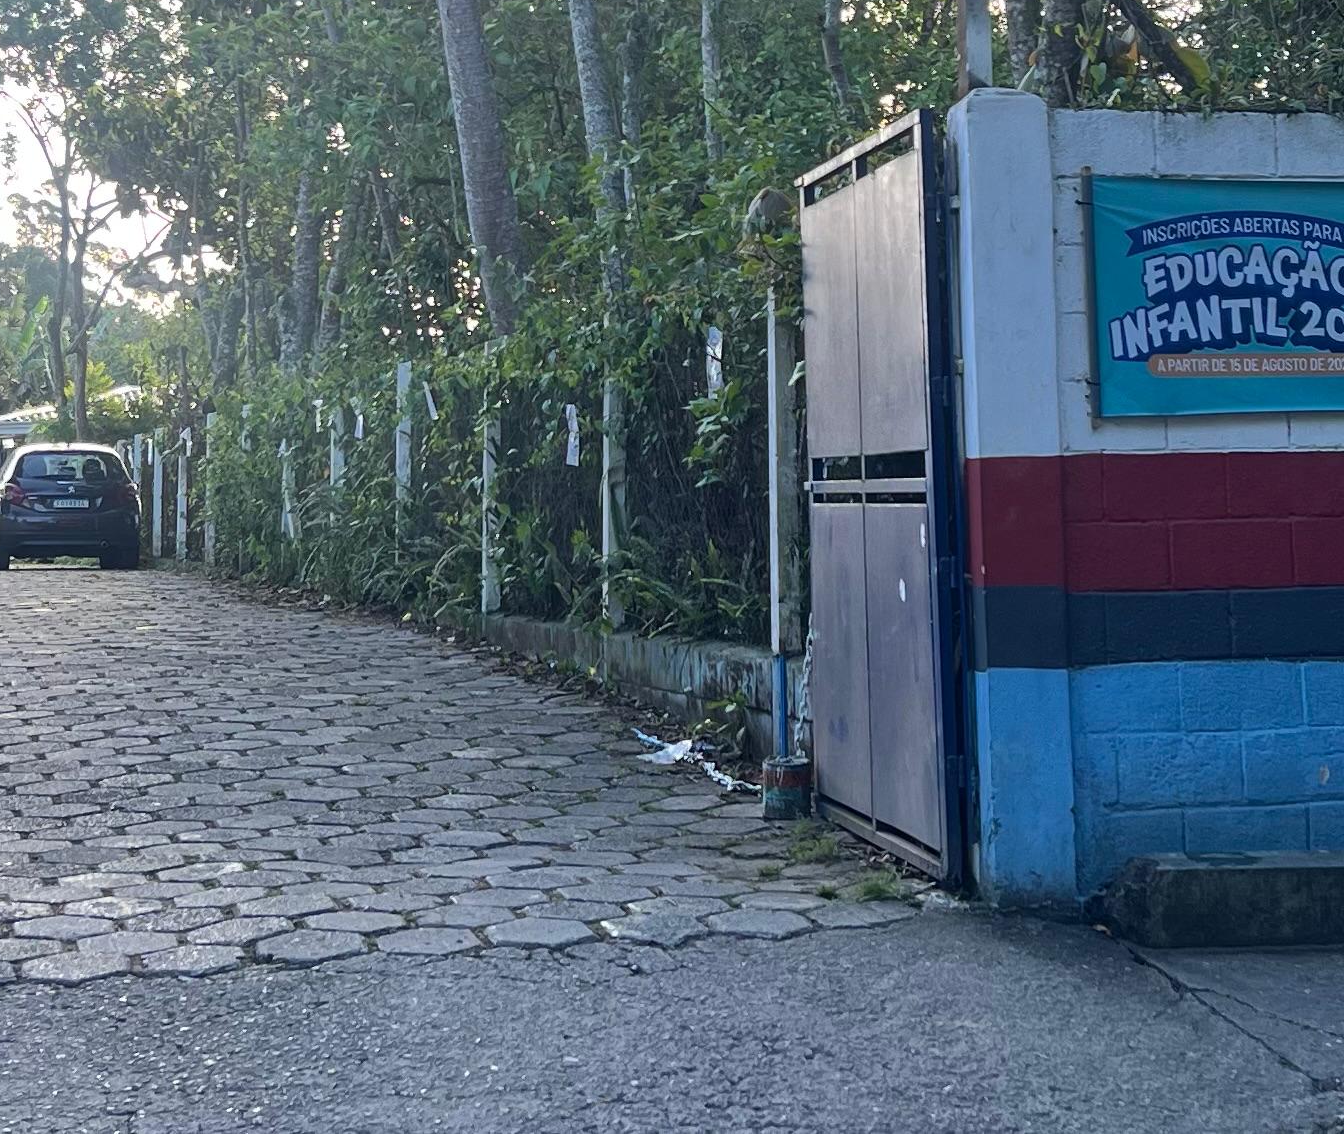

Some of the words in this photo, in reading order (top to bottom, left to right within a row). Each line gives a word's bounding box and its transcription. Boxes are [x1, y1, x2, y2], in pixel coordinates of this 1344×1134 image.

[1142, 215, 1231, 246] INSCRIÇÕES
[1233, 217, 1300, 236] ABERTAS
[1303, 221, 1343, 243] PARA
[1110, 294, 1288, 358] INFANTIL
[1157, 358, 1167, 372] A
[1167, 358, 1210, 372] PARTIR
[1211, 358, 1228, 372] DE
[1243, 358, 1260, 372] DE
[1262, 357, 1307, 372] AGOSTO
[1309, 357, 1327, 371] DE
